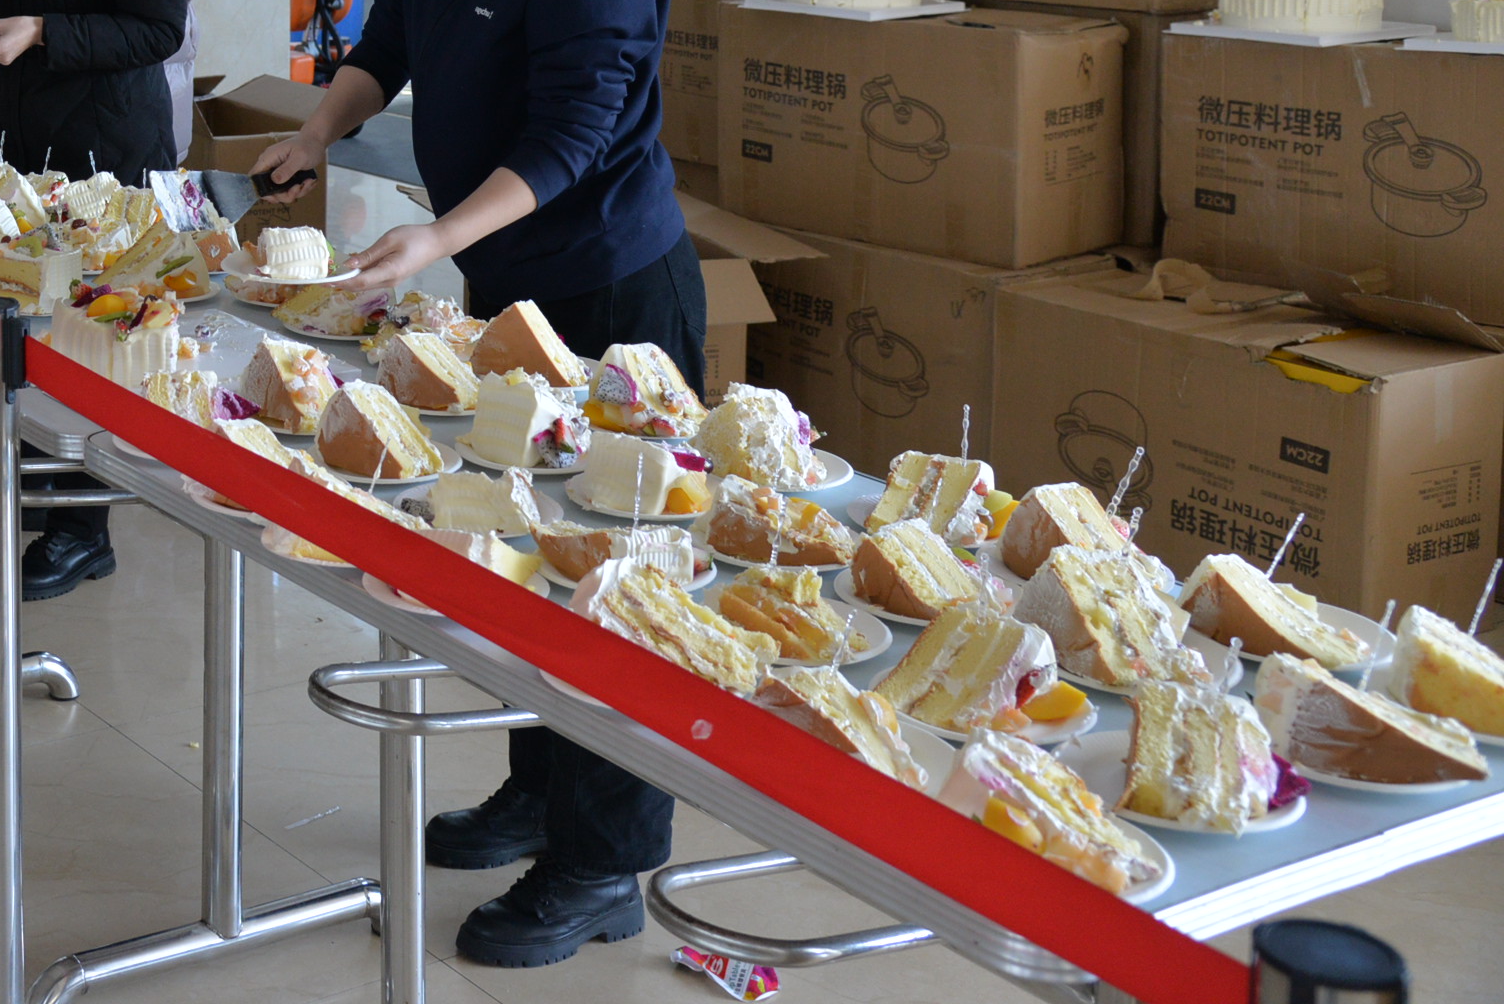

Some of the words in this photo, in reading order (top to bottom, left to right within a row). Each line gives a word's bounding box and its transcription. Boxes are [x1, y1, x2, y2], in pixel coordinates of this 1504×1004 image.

[743, 57, 847, 100] 微压料理锅
[742, 86, 809, 108] TOTIPOTENT
[812, 100, 834, 113] POT
[1198, 96, 1343, 141] 微压料理锅
[1196, 127, 1289, 153] TOTIPOTENT
[1293, 142, 1324, 157] POT
[1200, 194, 1231, 209] 22CM
[799, 323, 821, 337] POT
[1285, 444, 1325, 467] 22CM
[1188, 486, 1218, 507] POT
[1417, 524, 1433, 535] POT
[1435, 513, 1481, 531] TOTIPOTENT
[1170, 499, 1321, 579] 微压料理锅
[1407, 528, 1480, 565] 微压料理锅
